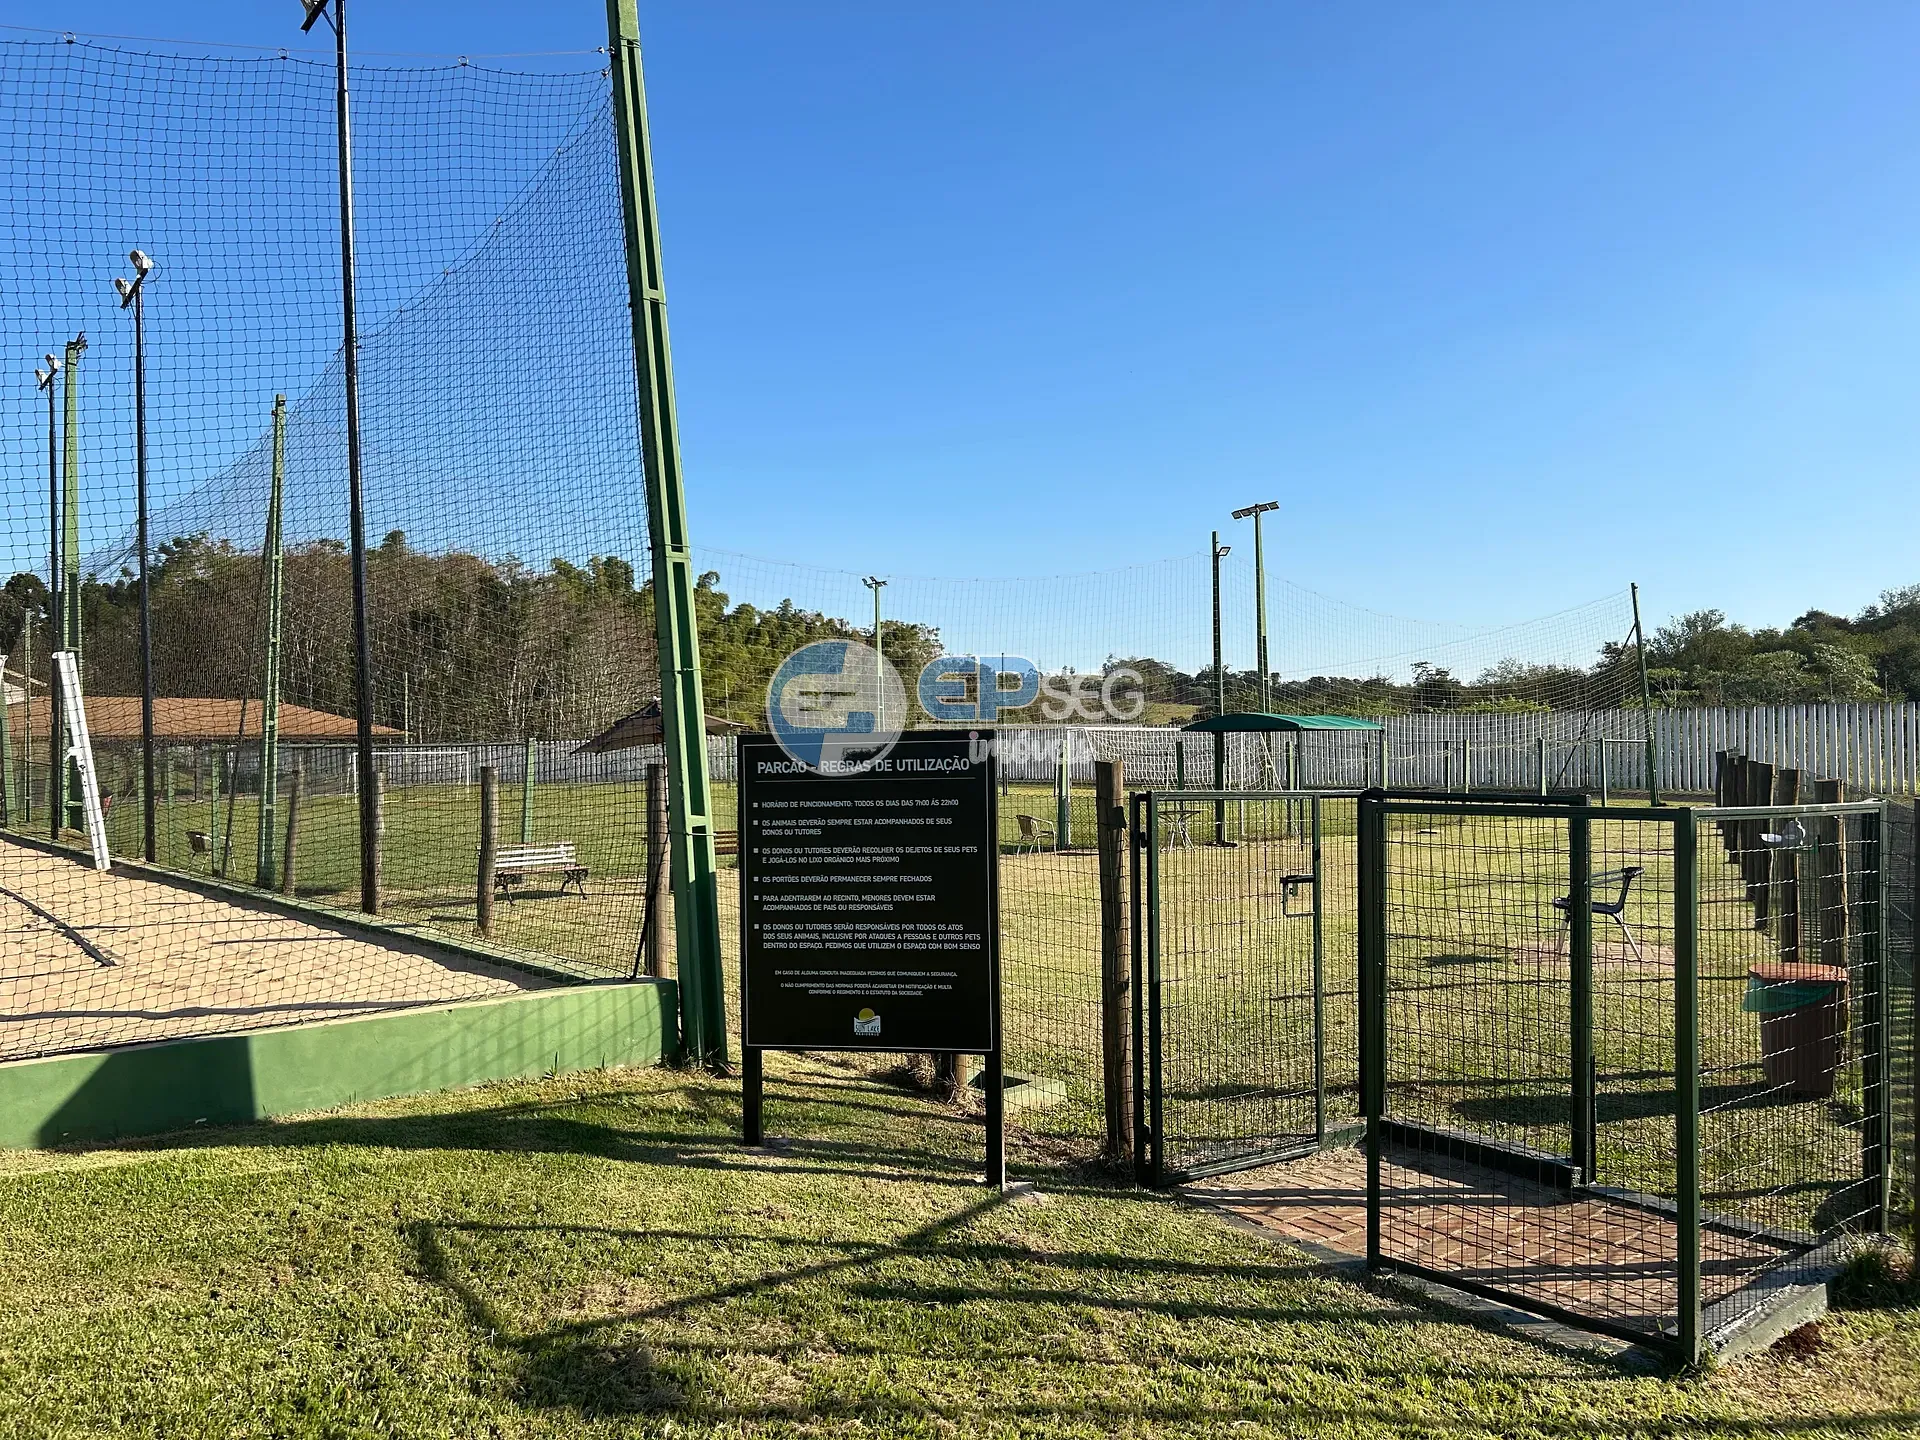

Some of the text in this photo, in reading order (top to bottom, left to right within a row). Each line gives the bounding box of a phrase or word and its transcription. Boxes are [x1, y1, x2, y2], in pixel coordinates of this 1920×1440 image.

[758, 757, 806, 773] PARCÃO
[821, 759, 871, 773] REGRAS
[876, 759, 892, 772] DE
[897, 756, 970, 774] UTILIZAÇÃO
[762, 800, 788, 808] HORÁRIO
[798, 818, 826, 826] DEVERÃO
[833, 846, 861, 854] DEVERÃO
[824, 855, 854, 863] ORGÂNICO
[872, 855, 900, 863] PRÓXIMO
[848, 903, 894, 911] RESPONSÁVEIS
[833, 922, 854, 930] SERÃO
[794, 933, 820, 941] ANIMAIS,
[799, 942, 824, 950] ESPAÇO.
